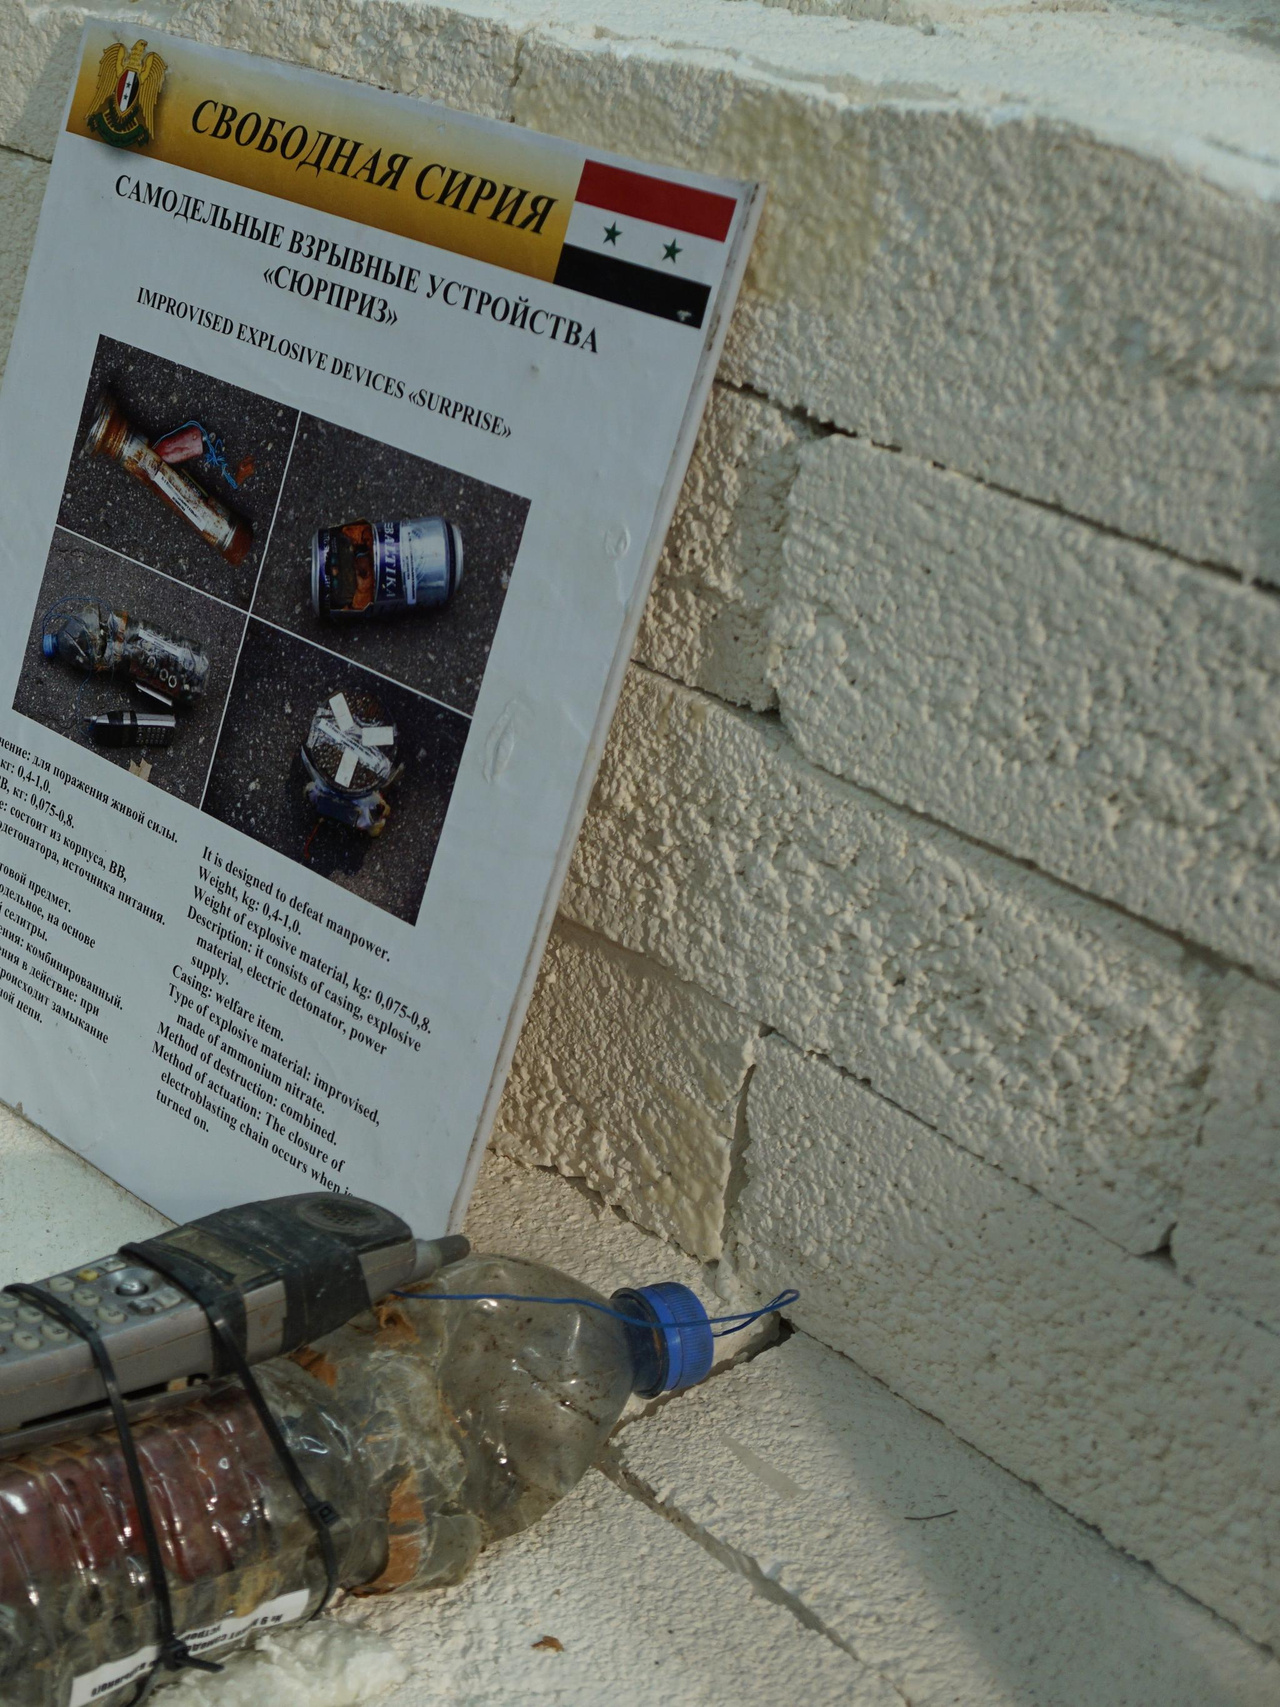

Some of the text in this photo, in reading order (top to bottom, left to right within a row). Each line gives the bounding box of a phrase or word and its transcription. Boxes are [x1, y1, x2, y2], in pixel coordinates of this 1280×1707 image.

[191, 99, 558, 235] СВОБОДНАЯ СИРИЯ
[115, 174, 598, 354] САМОДЕЛЬНЫЕ ВЗРЫВНЫЕ УСТРОЙСТВА
[263, 265, 398, 326] «СЮРПРИЗ»
[136, 286, 512, 438] IMPROVISED EXPLOSIVE DEVICES «SURPRISE»
[0, 758, 16, 774] кг:
[17, 765, 51, 795] 0,4-1,0.
[12, 786, 29, 802] кг:
[29, 793, 75, 830] 0,075-0,8.
[31, 755, 52, 773] для
[52, 766, 110, 805] поражения
[110, 798, 146, 825] живой
[146, 818, 178, 844] силы.
[9, 806, 49, 834] состоит
[49, 828, 62, 843] из
[62, 836, 106, 872] корпуса,
[108, 859, 127, 884] ВВ,
[3, 907, 48, 942] селитры.
[27, 879, 72, 914] предмет.
[46, 912, 60, 927] на
[61, 921, 96, 949] основе
[61, 857, 116, 897] источника
[117, 890, 166, 926] питания.
[199, 865, 302, 936] Weight, kg: 0,4-1,0.
[201, 845, 390, 963] It is designed to defeat manpower.
[21, 960, 29, 971] в
[28, 965, 78, 1003] действие:
[79, 997, 100, 1017] при
[25, 941, 123, 1011] комбинированный.
[186, 904, 422, 1053] Description: it consists of casing, explosive
[190, 955, 229, 986] supply.
[193, 884, 431, 1035] Weight of explosive material, kg: 0,075-0,8.
[196, 936, 388, 1055] material, electric detonator, power
[15, 999, 43, 1024] цепи.
[50, 1000, 109, 1044] замыкание
[172, 964, 284, 1042] Casing: welfare item.
[156, 1020, 337, 1147] Method of destruction: combined.
[168, 982, 380, 1128] Type of explosive material: improvised,
[176, 1013, 325, 1115] made of ammonium nitrate.
[151, 1039, 346, 1173] Method of actuation: The closure of
[155, 1088, 209, 1133] turned on.
[160, 1071, 238, 1131] electroblasting
[239, 1122, 270, 1149] chain
[271, 1143, 309, 1174] occurs
[311, 1168, 341, 1195] when
